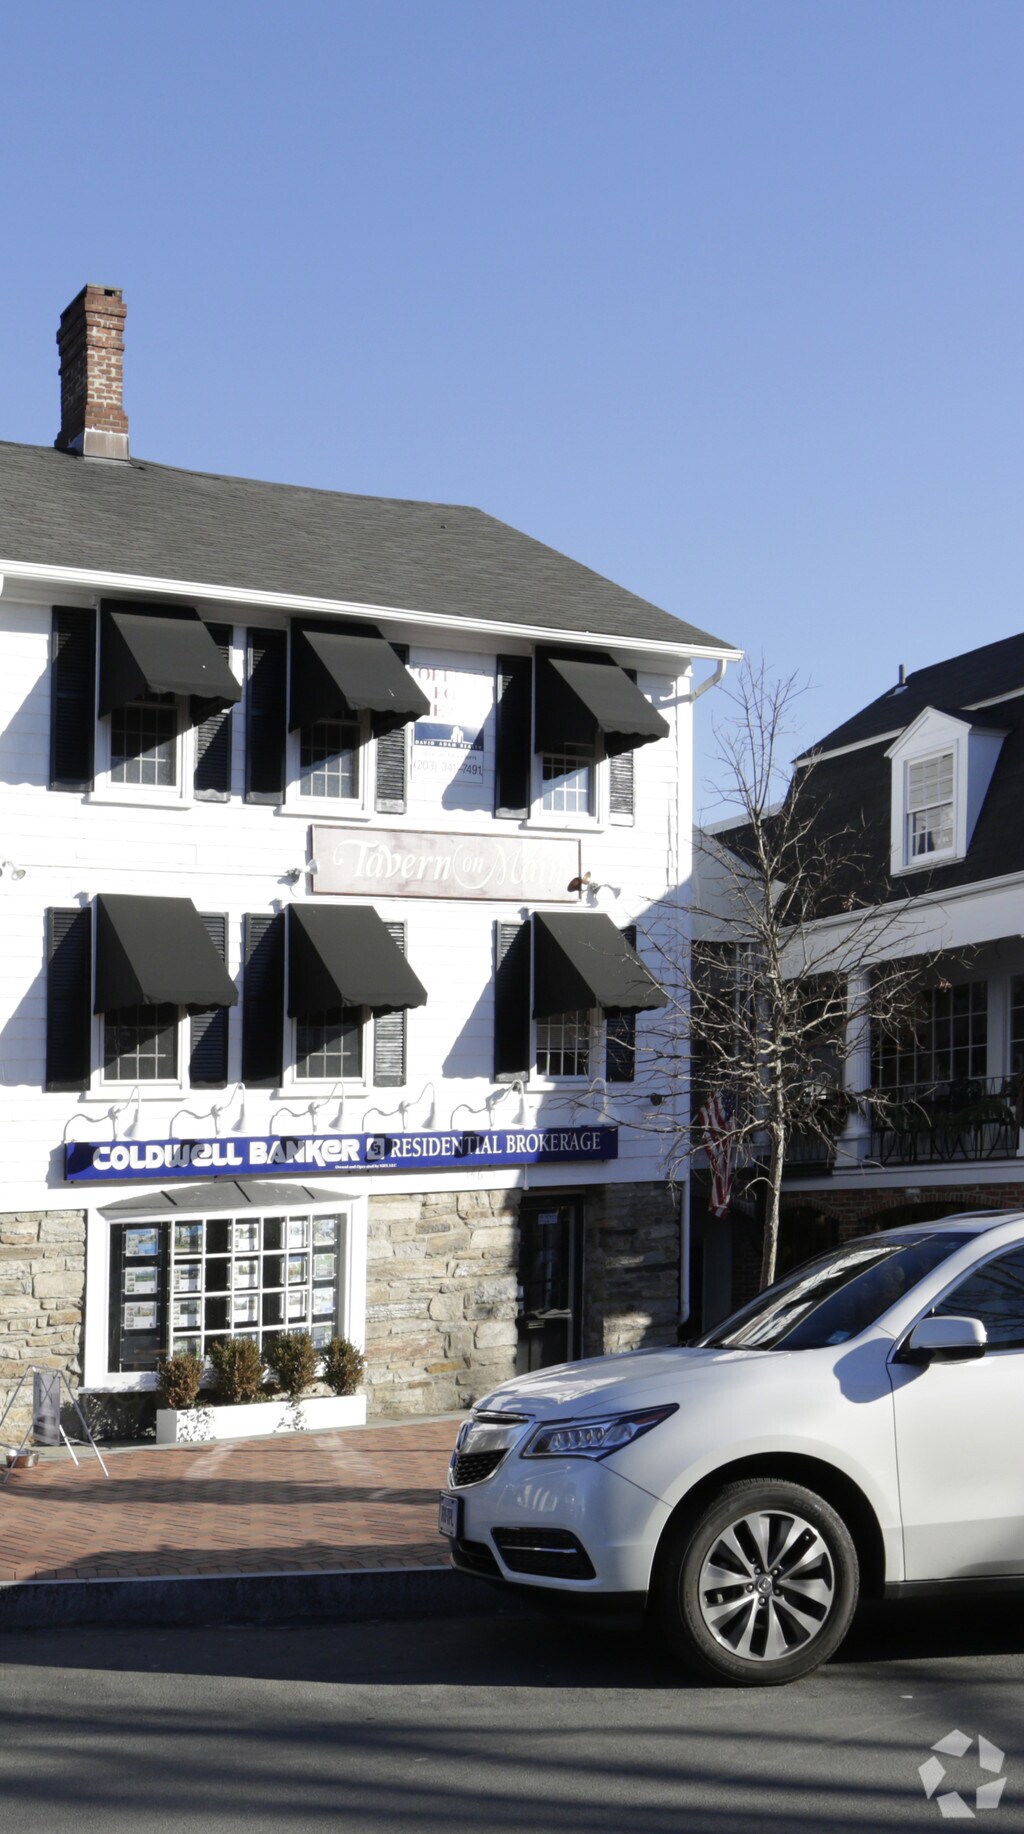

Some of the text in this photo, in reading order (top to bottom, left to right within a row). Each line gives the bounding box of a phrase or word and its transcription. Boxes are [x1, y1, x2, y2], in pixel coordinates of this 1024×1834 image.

[413, 760, 437, 773] (203)
[333, 840, 564, 886] Tavern on Main
[93, 1138, 361, 1171] COLDWELL BANKER
[390, 1131, 601, 1157] RESIDENTIAL BROKERAGE
